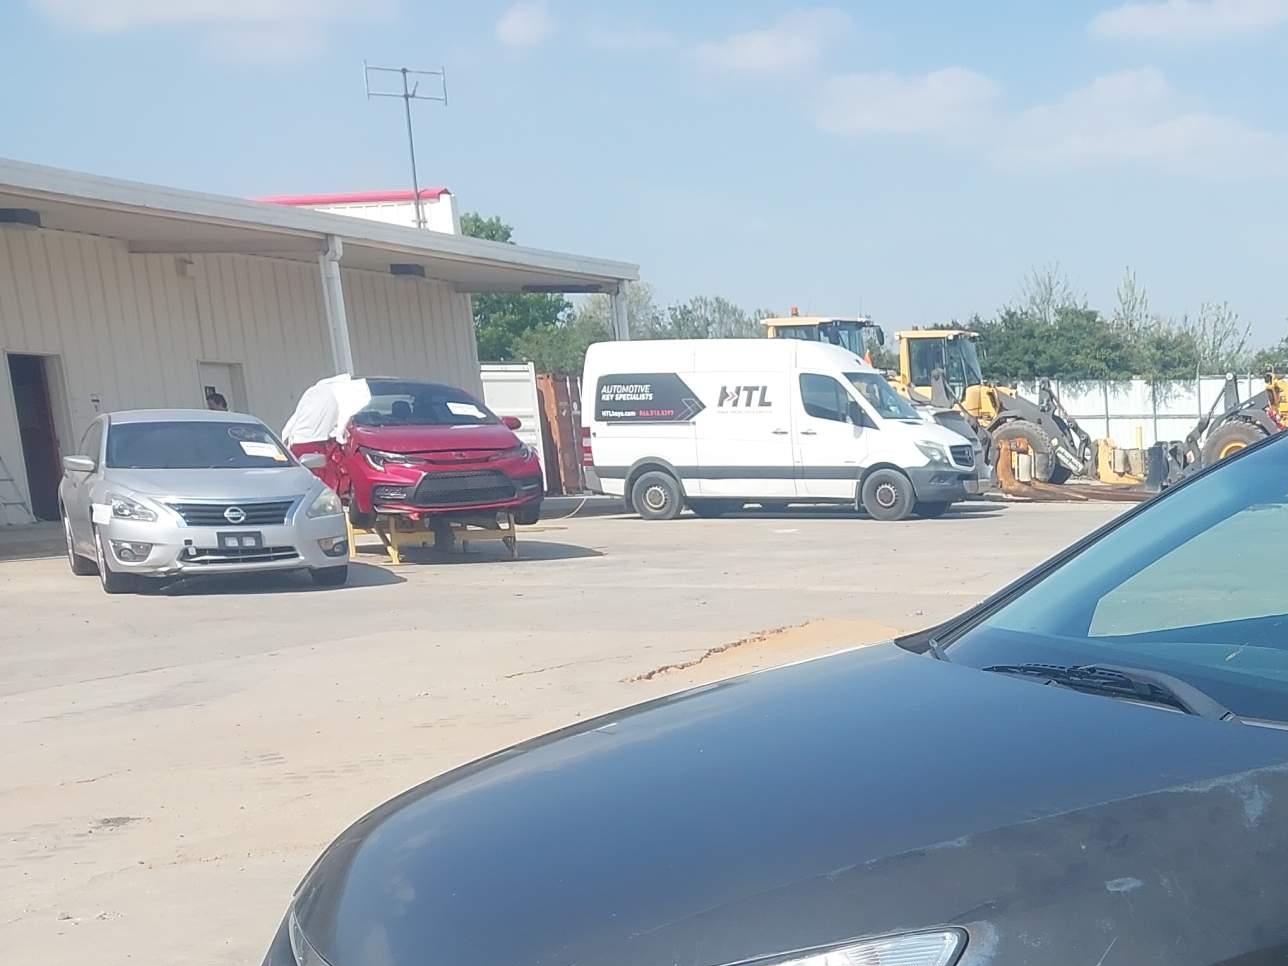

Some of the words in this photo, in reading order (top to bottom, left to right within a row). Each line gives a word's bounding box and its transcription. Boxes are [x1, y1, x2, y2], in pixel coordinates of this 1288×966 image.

[601, 384, 651, 394] AUTOMOTIVE
[601, 393, 613, 401] KEY
[614, 393, 653, 401] SPECIALISTS
[717, 386, 772, 407] HTL
